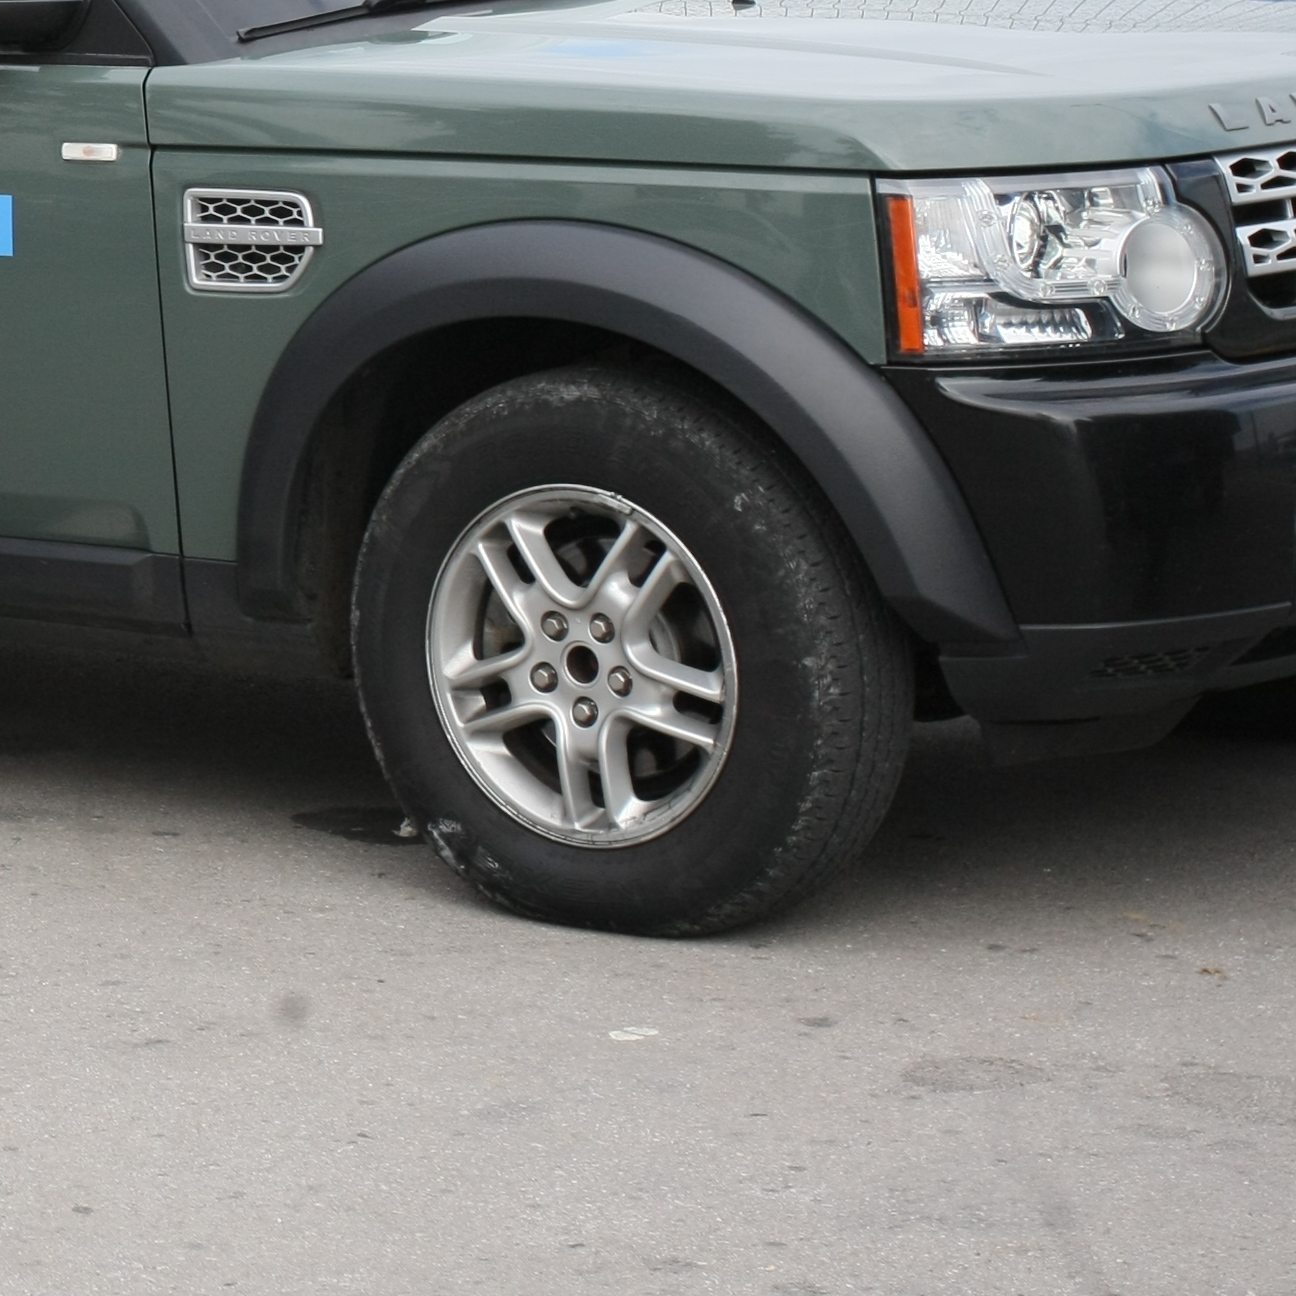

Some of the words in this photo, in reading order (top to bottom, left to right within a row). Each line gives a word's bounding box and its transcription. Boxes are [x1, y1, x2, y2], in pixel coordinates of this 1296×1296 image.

[1208, 92, 1296, 132] LA
[190, 229, 238, 241] LAND
[248, 231, 311, 243] ROVER
